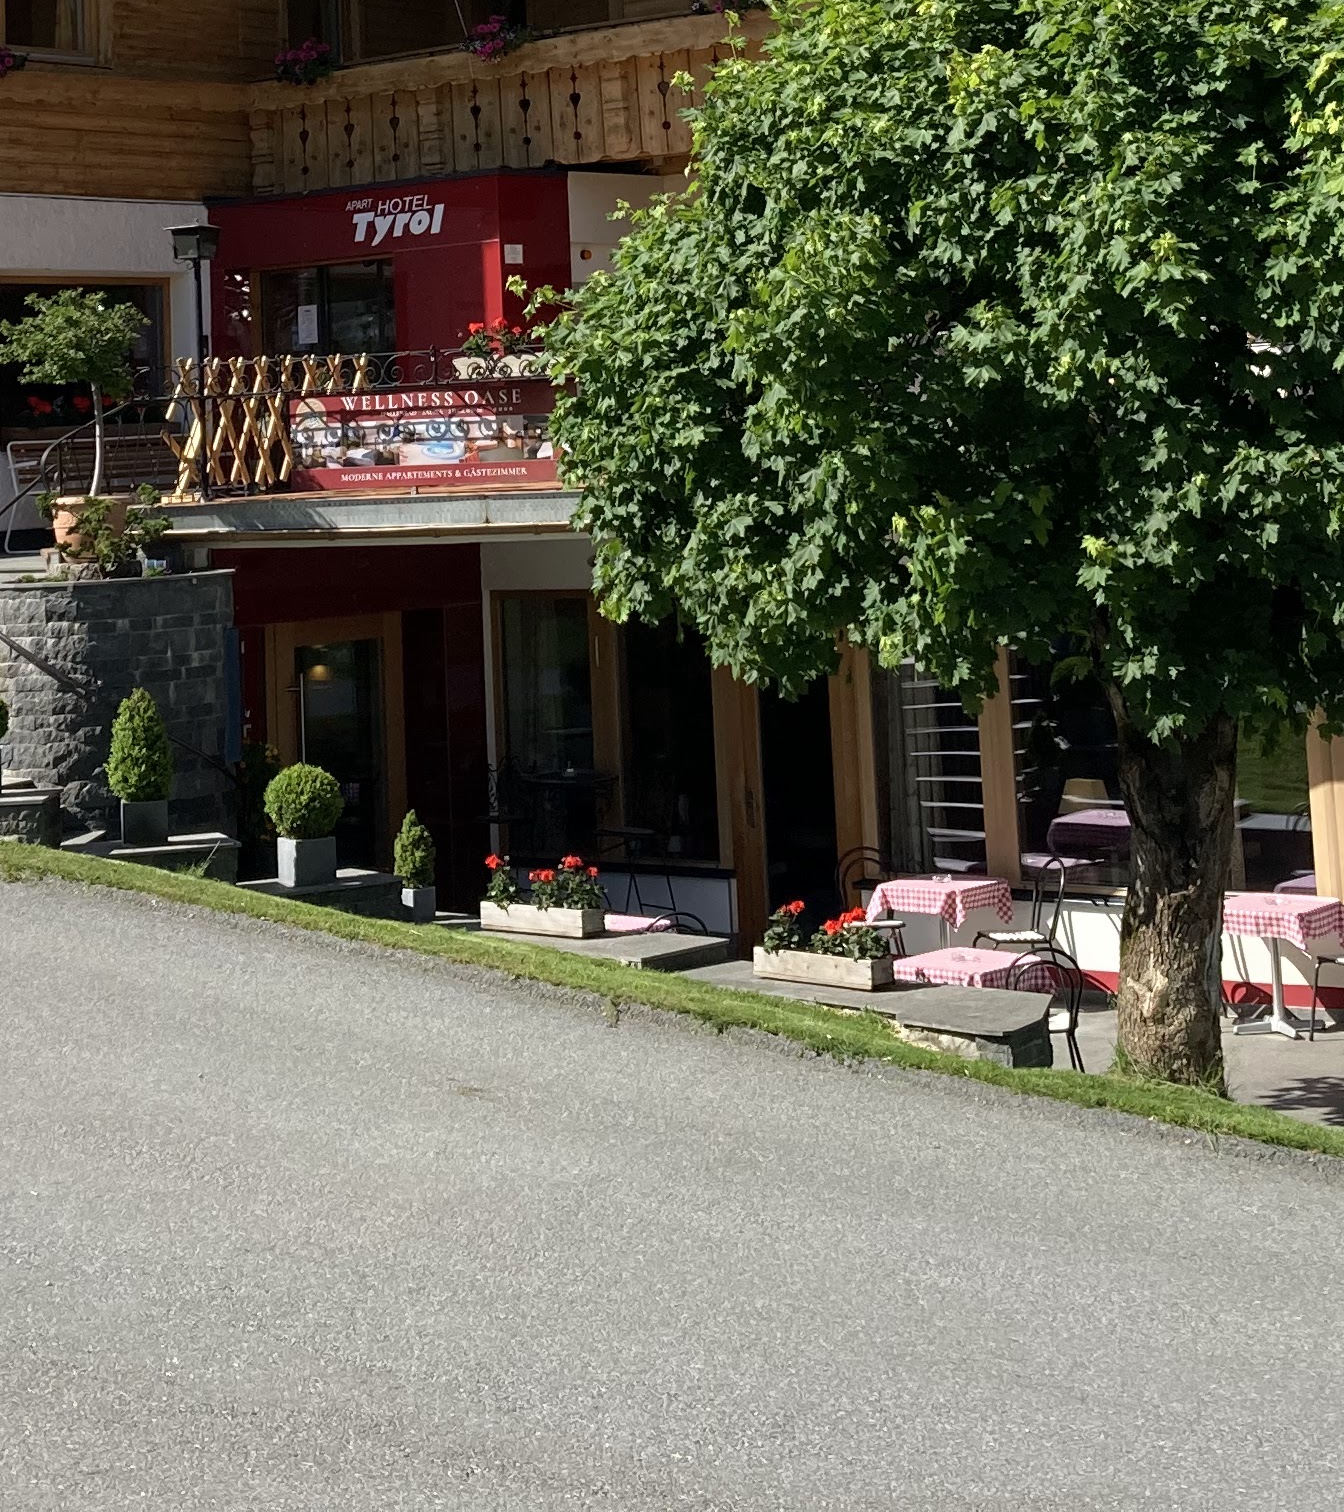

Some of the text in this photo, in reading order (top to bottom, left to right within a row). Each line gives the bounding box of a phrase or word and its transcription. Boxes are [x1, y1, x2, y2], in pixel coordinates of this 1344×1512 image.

[345, 194, 433, 215] APART HOTEL
[352, 203, 445, 247] Tyrol
[341, 388, 522, 411] WELLNESS OASE
[340, 466, 528, 482] MODERNE APPARTEMENTS & GÄSTEZIMMER
